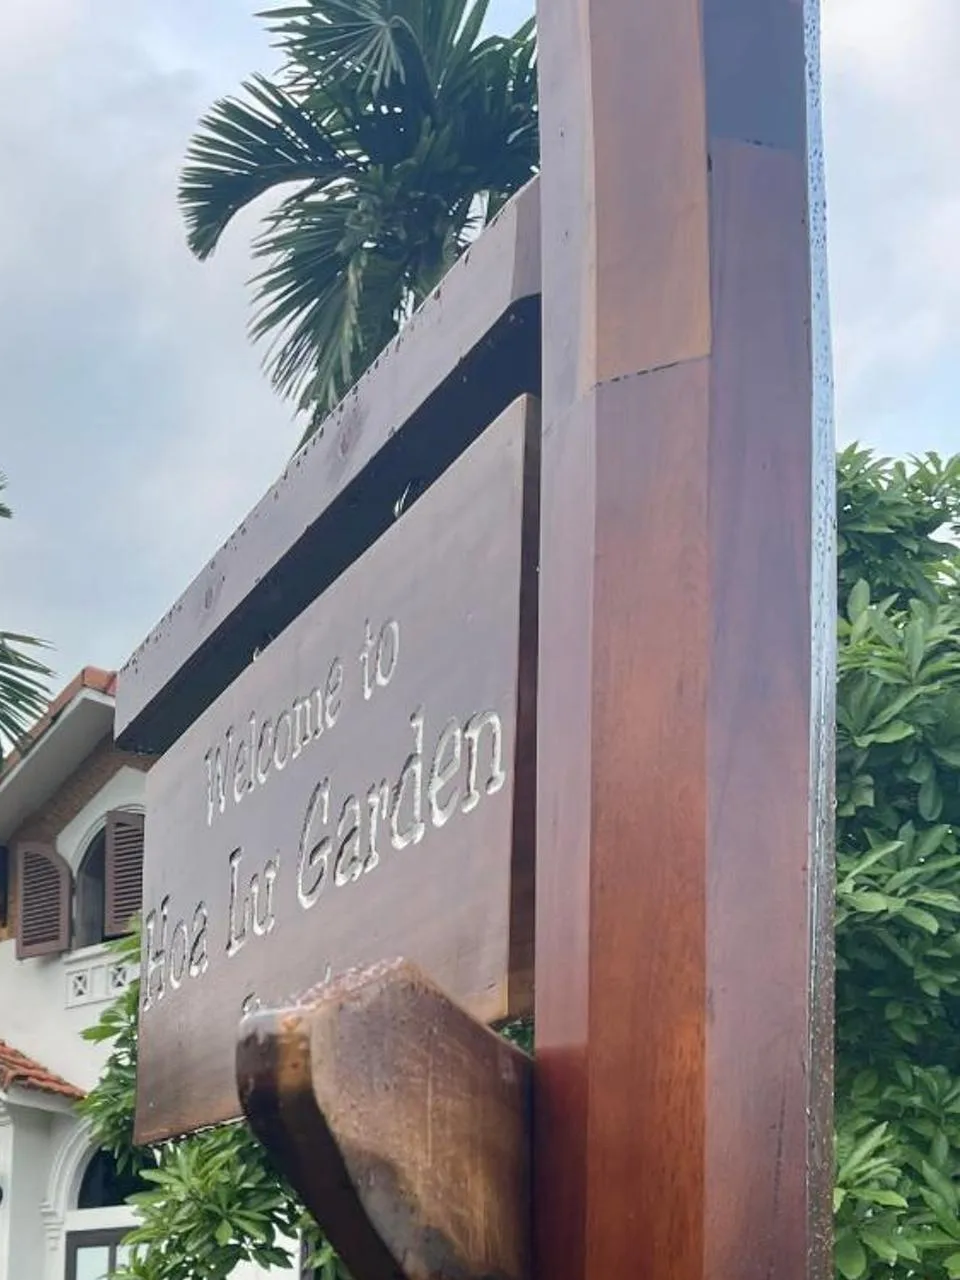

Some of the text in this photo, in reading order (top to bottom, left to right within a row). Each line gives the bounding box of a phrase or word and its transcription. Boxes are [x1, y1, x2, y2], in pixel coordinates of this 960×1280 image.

[204, 617, 400, 827] Welcome to
[144, 894, 209, 1012] Hoa
[297, 705, 506, 909] Garden
